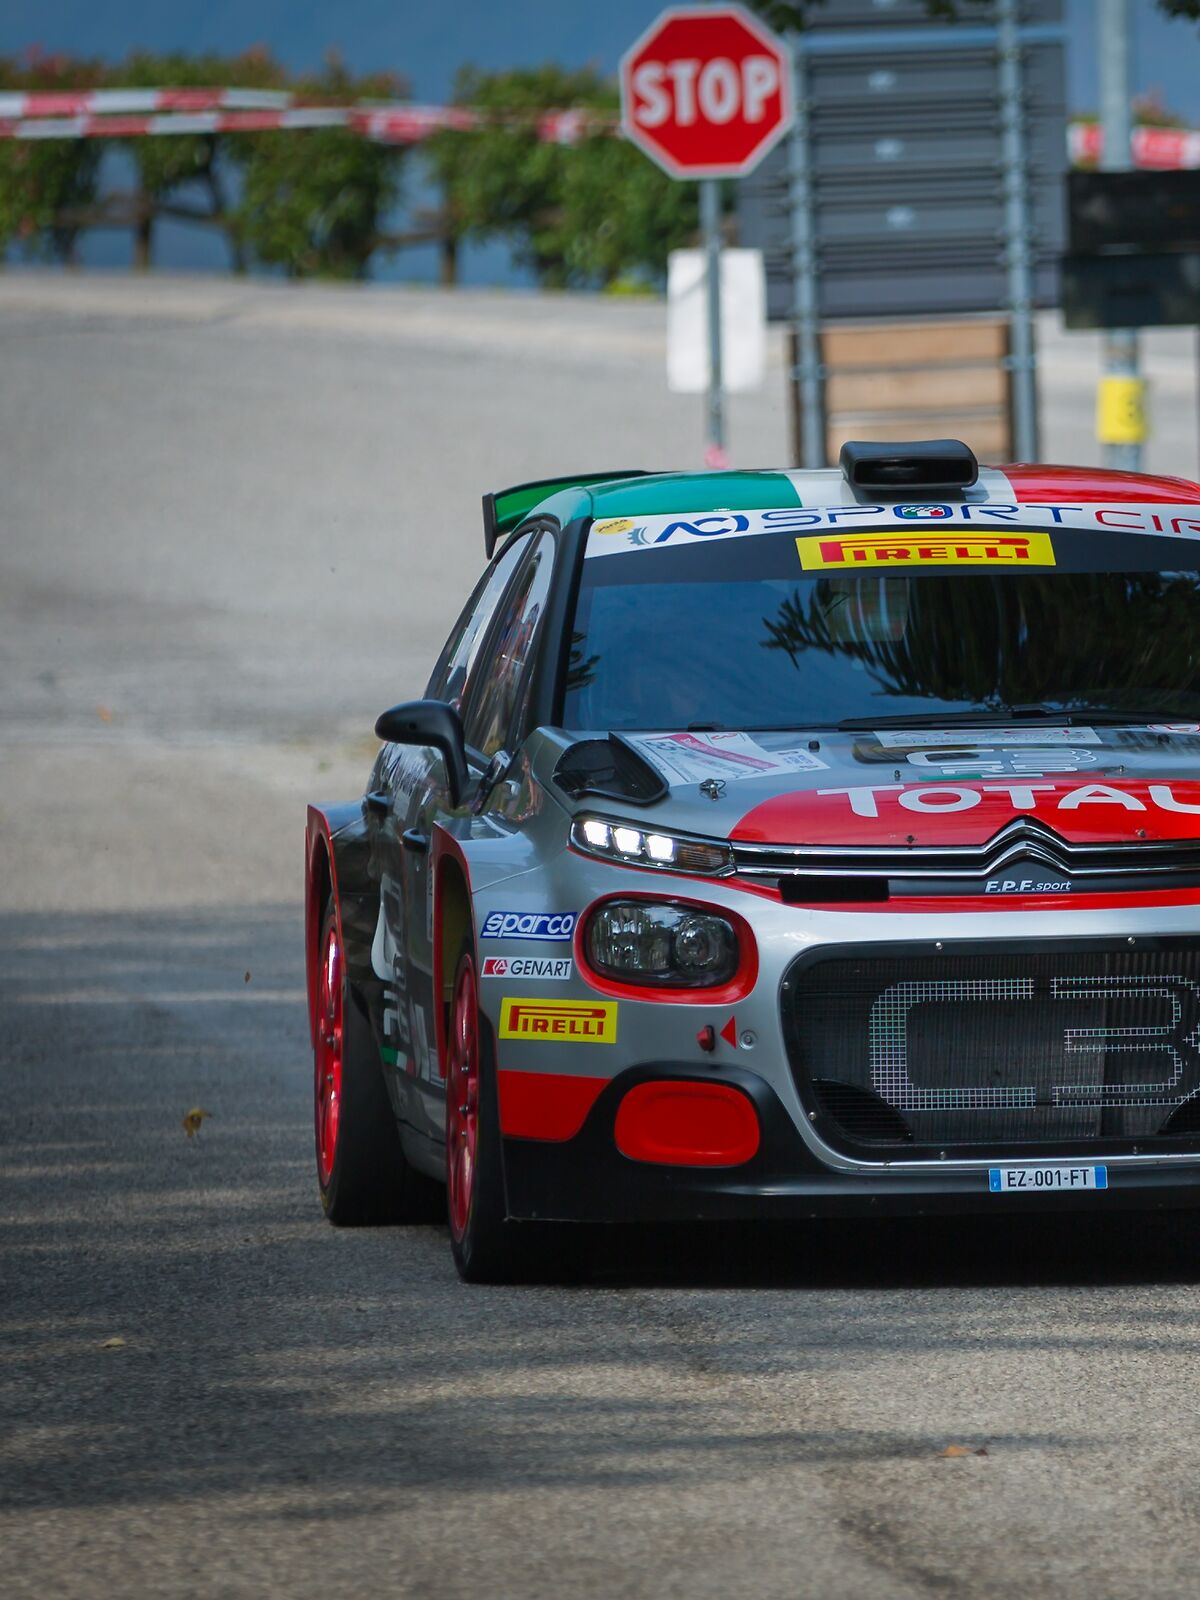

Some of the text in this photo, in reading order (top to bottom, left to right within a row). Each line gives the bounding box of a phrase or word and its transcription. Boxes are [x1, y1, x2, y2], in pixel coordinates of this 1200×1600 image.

[633, 55, 780, 128] STOP
[818, 537, 1030, 563] PIRELLI
[486, 913, 573, 938] sparco
[510, 959, 570, 976] GENART
[508, 1005, 606, 1036] PIRELLI
[1007, 1169, 1089, 1187] EZ-001-FT
